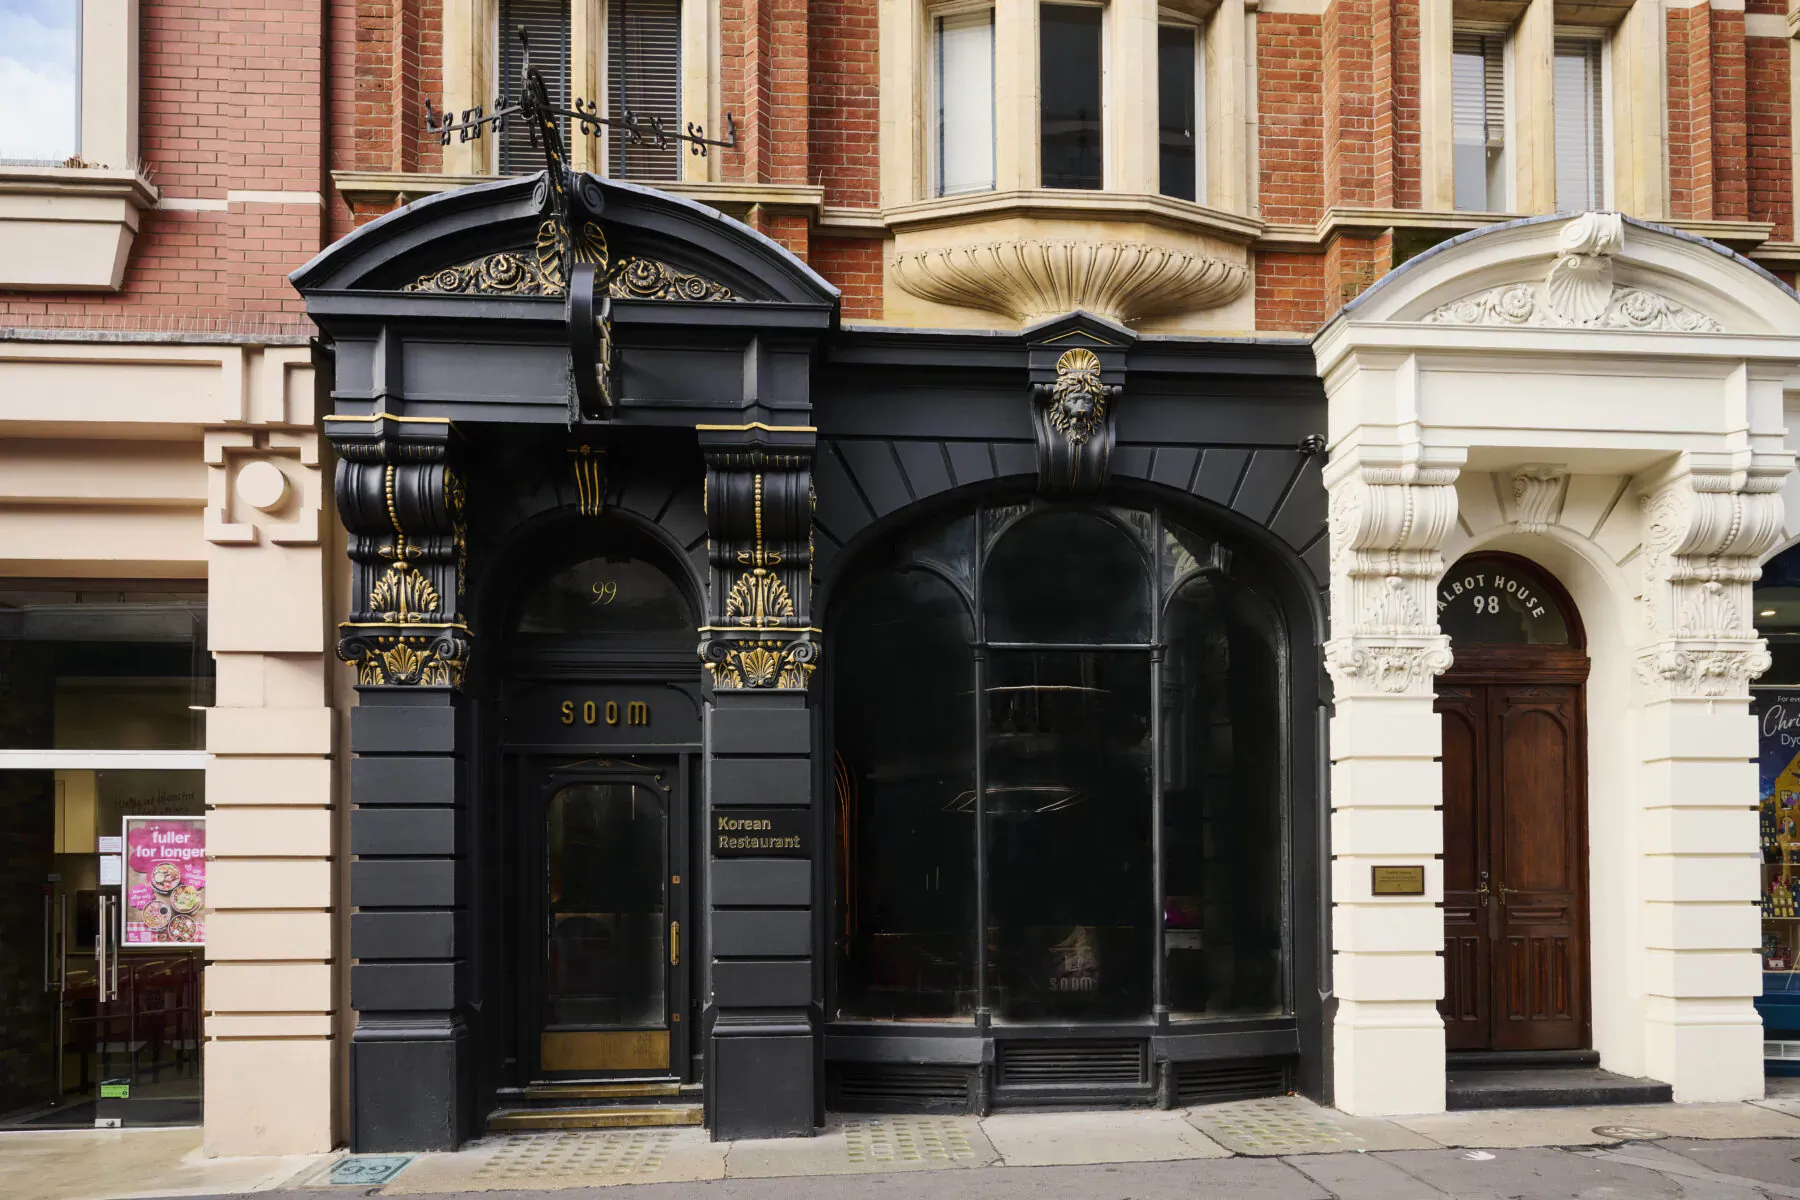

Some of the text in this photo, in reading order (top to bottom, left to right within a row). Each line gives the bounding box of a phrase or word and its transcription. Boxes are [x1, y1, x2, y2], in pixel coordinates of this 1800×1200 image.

[592, 581, 617, 605] 99
[1437, 575, 1545, 618] ALBOT HOUSE
[1473, 595, 1500, 614] 98
[1777, 695, 1789, 703] For
[1763, 704, 1800, 737] Chri
[718, 816, 772, 830] Korean
[152, 831, 191, 844] fuller
[718, 835, 801, 849] Restaurant
[136, 845, 206, 860] for longer
